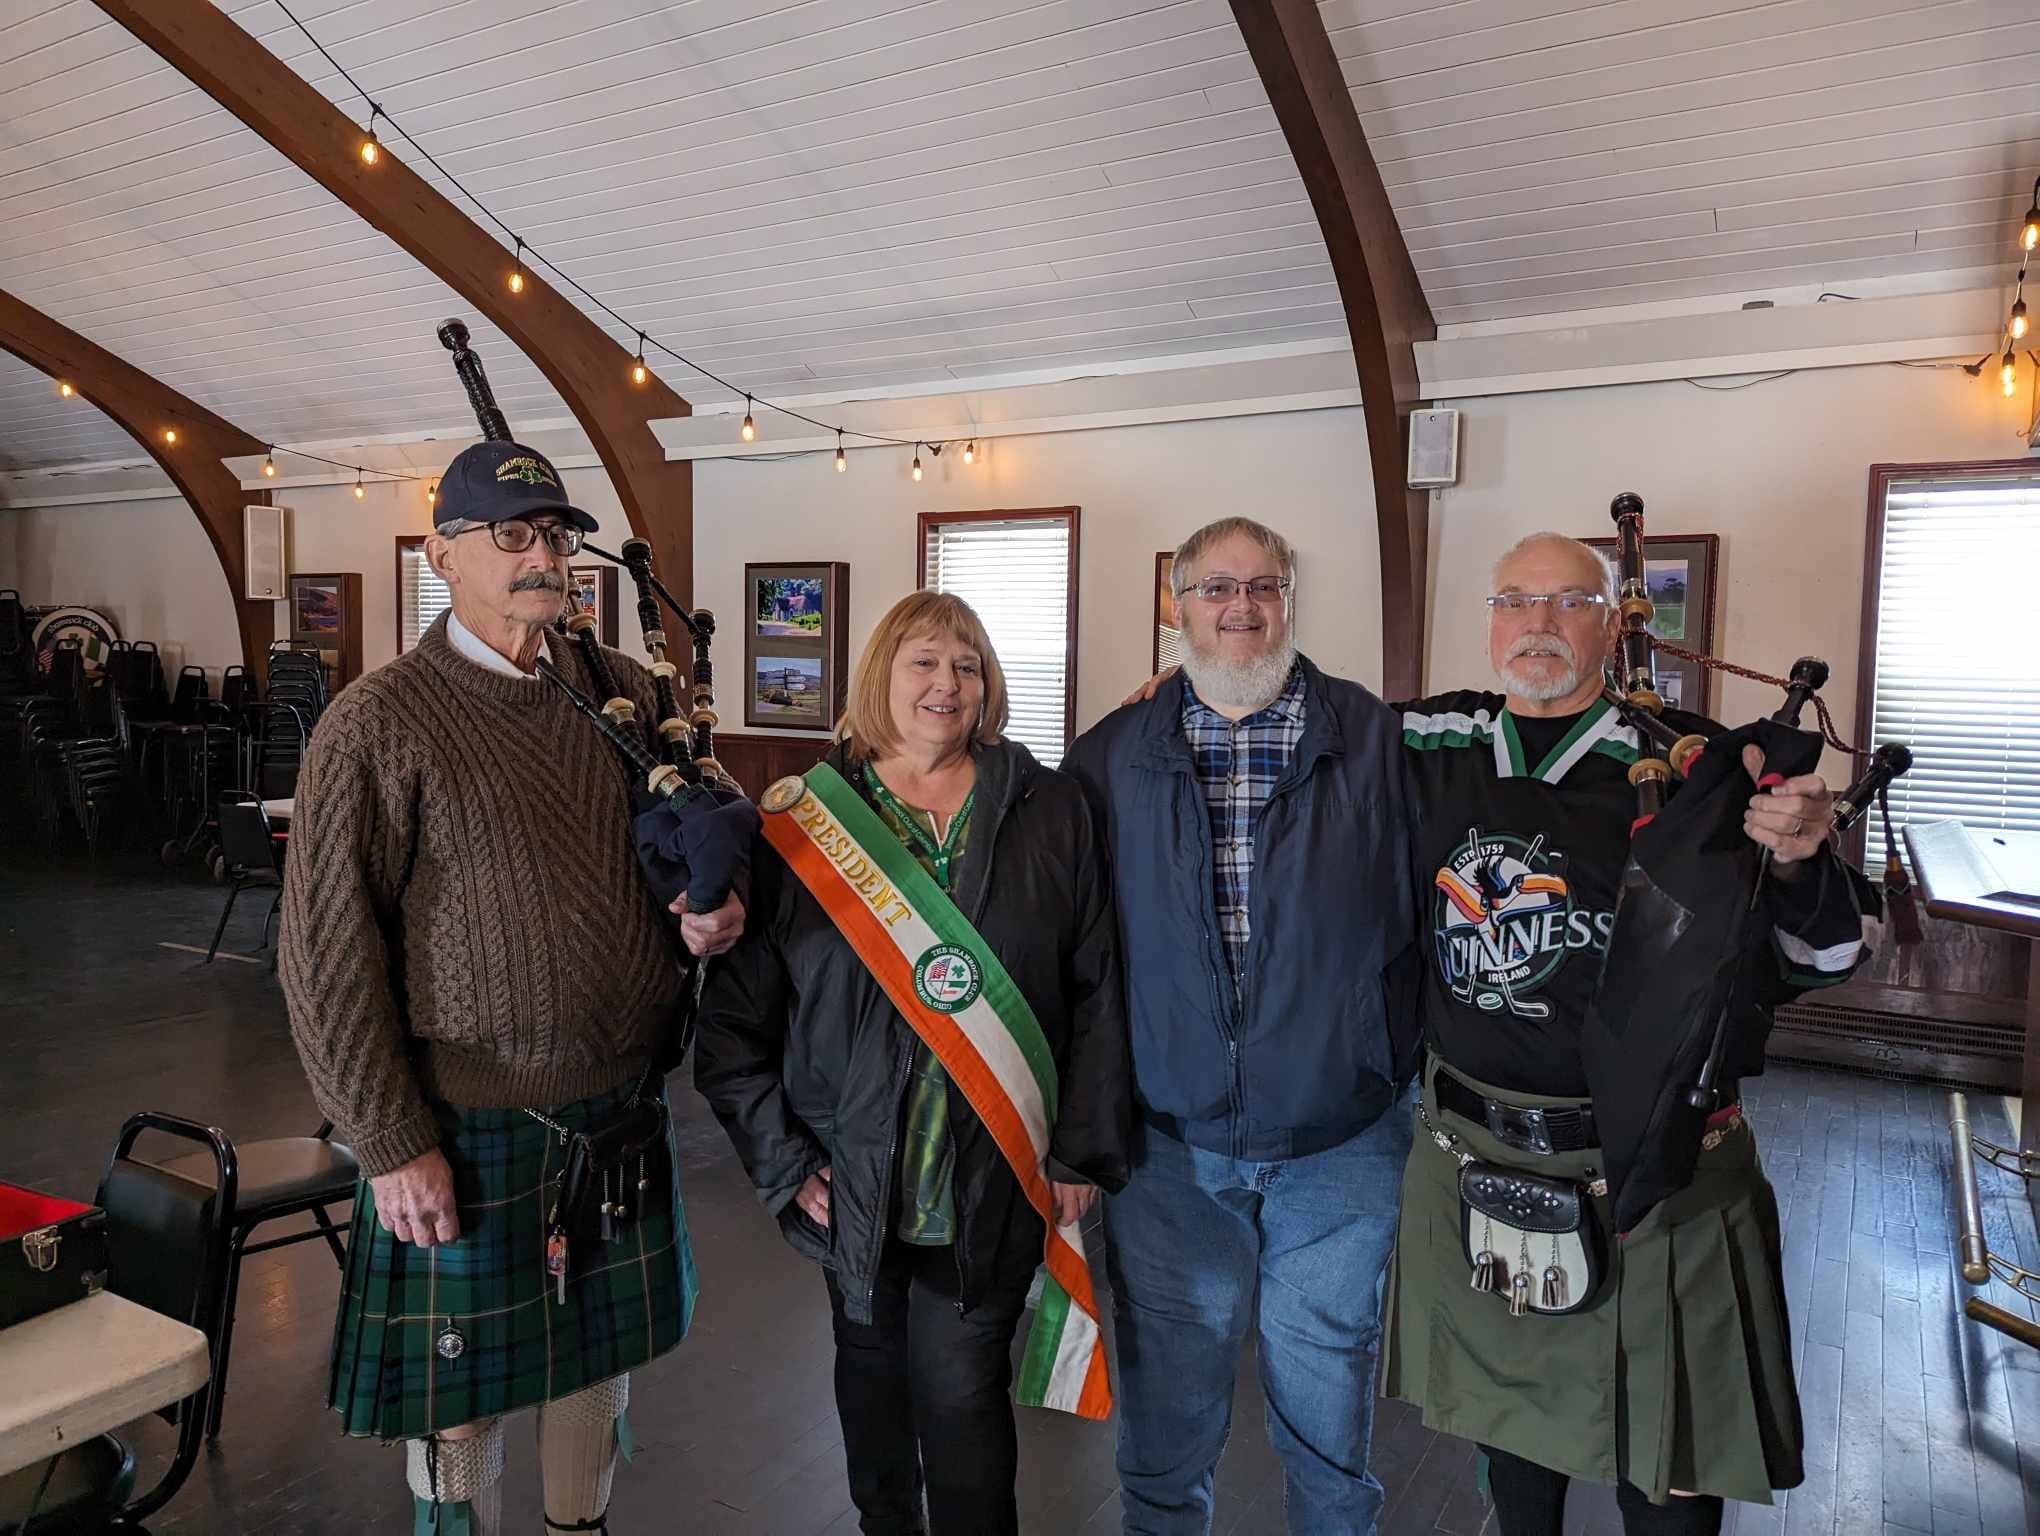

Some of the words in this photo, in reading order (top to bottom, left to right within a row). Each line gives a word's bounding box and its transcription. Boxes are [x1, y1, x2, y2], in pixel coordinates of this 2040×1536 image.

[1480, 844, 1504, 857] 1759
[791, 796, 912, 926] PRESIDENT
[930, 947, 948, 957] THE
[949, 946, 979, 981] SHAMROCK
[1487, 965, 1531, 983] IRELAND
[932, 1001, 952, 1010] OHIO
